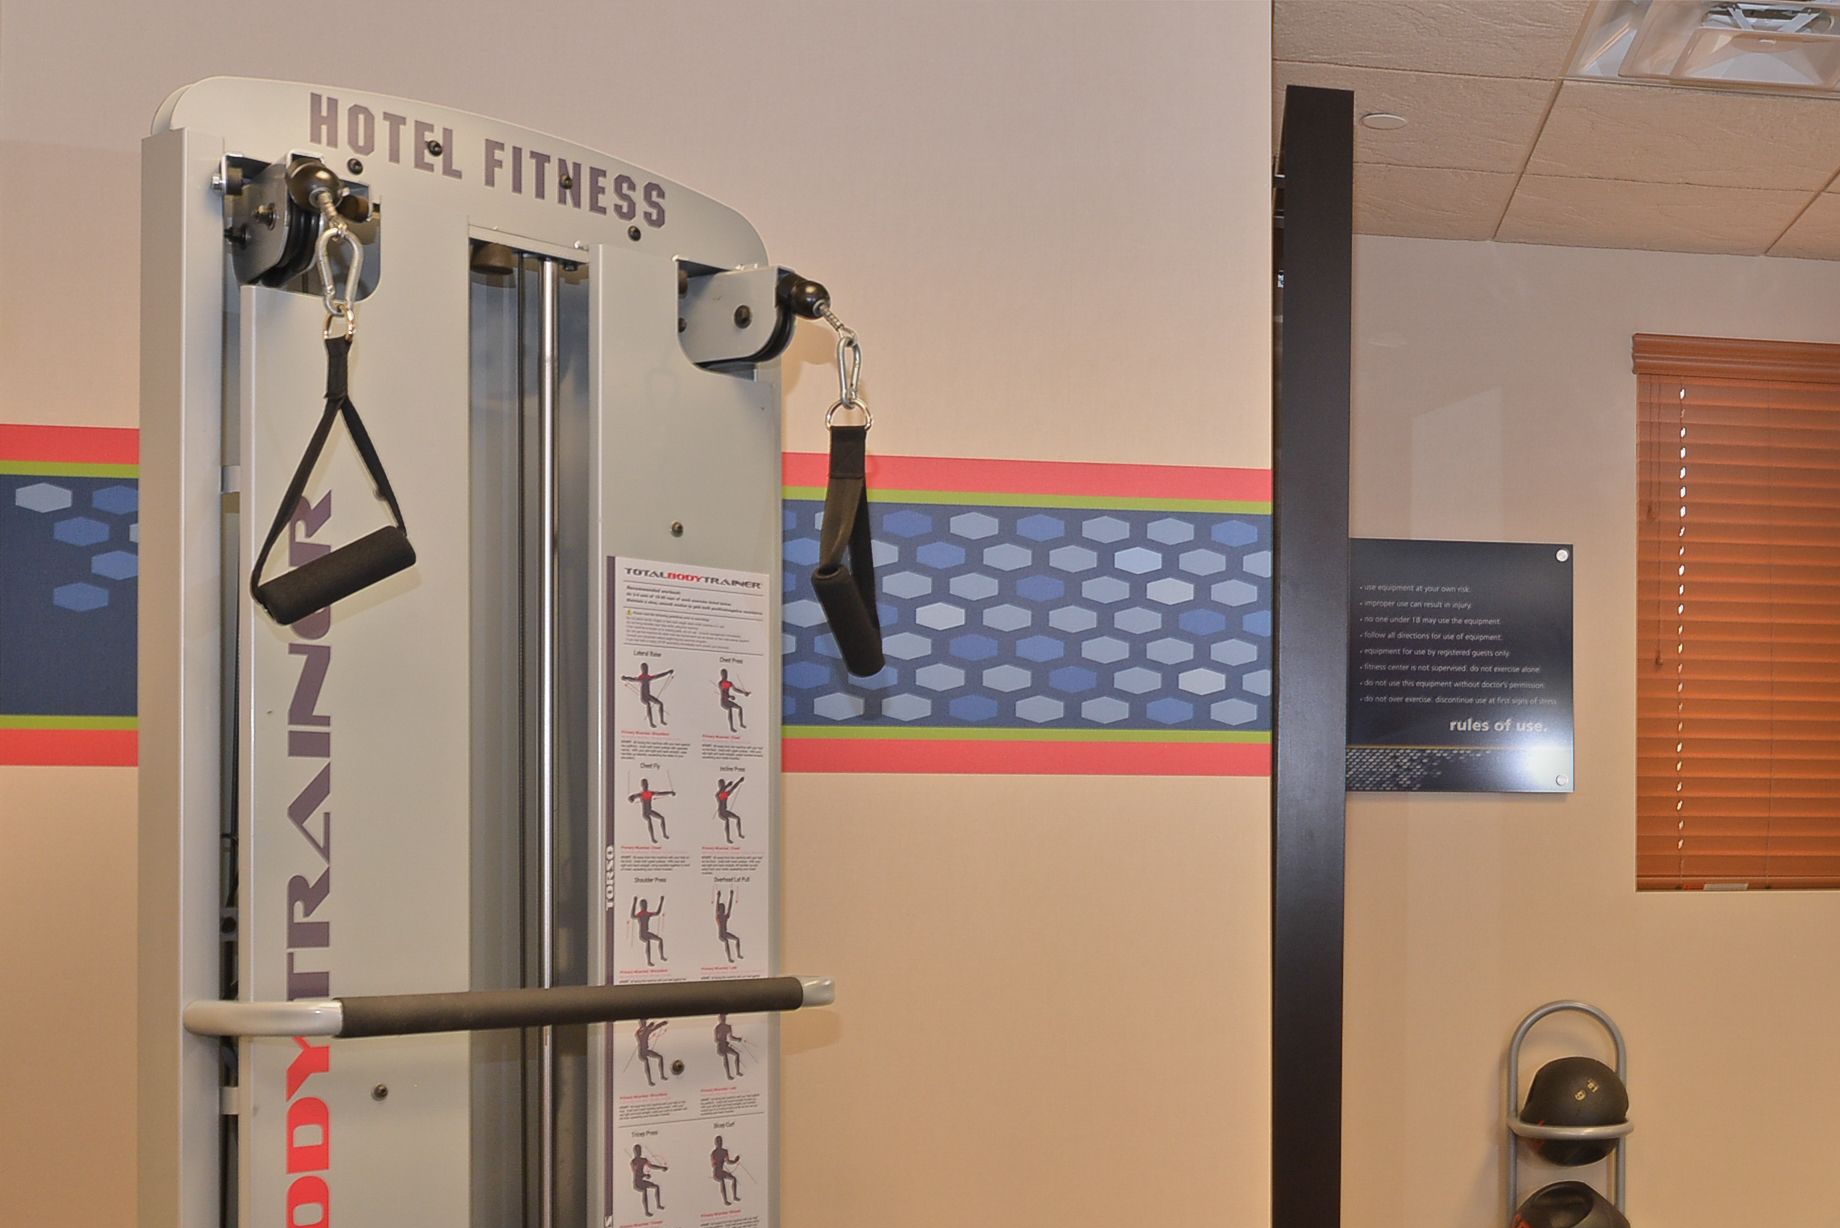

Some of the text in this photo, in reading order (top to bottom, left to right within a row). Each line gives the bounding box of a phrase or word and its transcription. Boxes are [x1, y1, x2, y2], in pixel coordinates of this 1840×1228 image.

[309, 92, 665, 229] HOTEL FITNESS
[1377, 584, 1414, 592] equipment
[1364, 600, 1395, 608] improper
[1422, 617, 1437, 625] may
[1397, 631, 1429, 639] directions
[1437, 649, 1471, 657] registered
[1472, 650, 1493, 658] guests
[1449, 717, 1548, 732] rules of use.
[606, 845, 615, 911] TORSO
